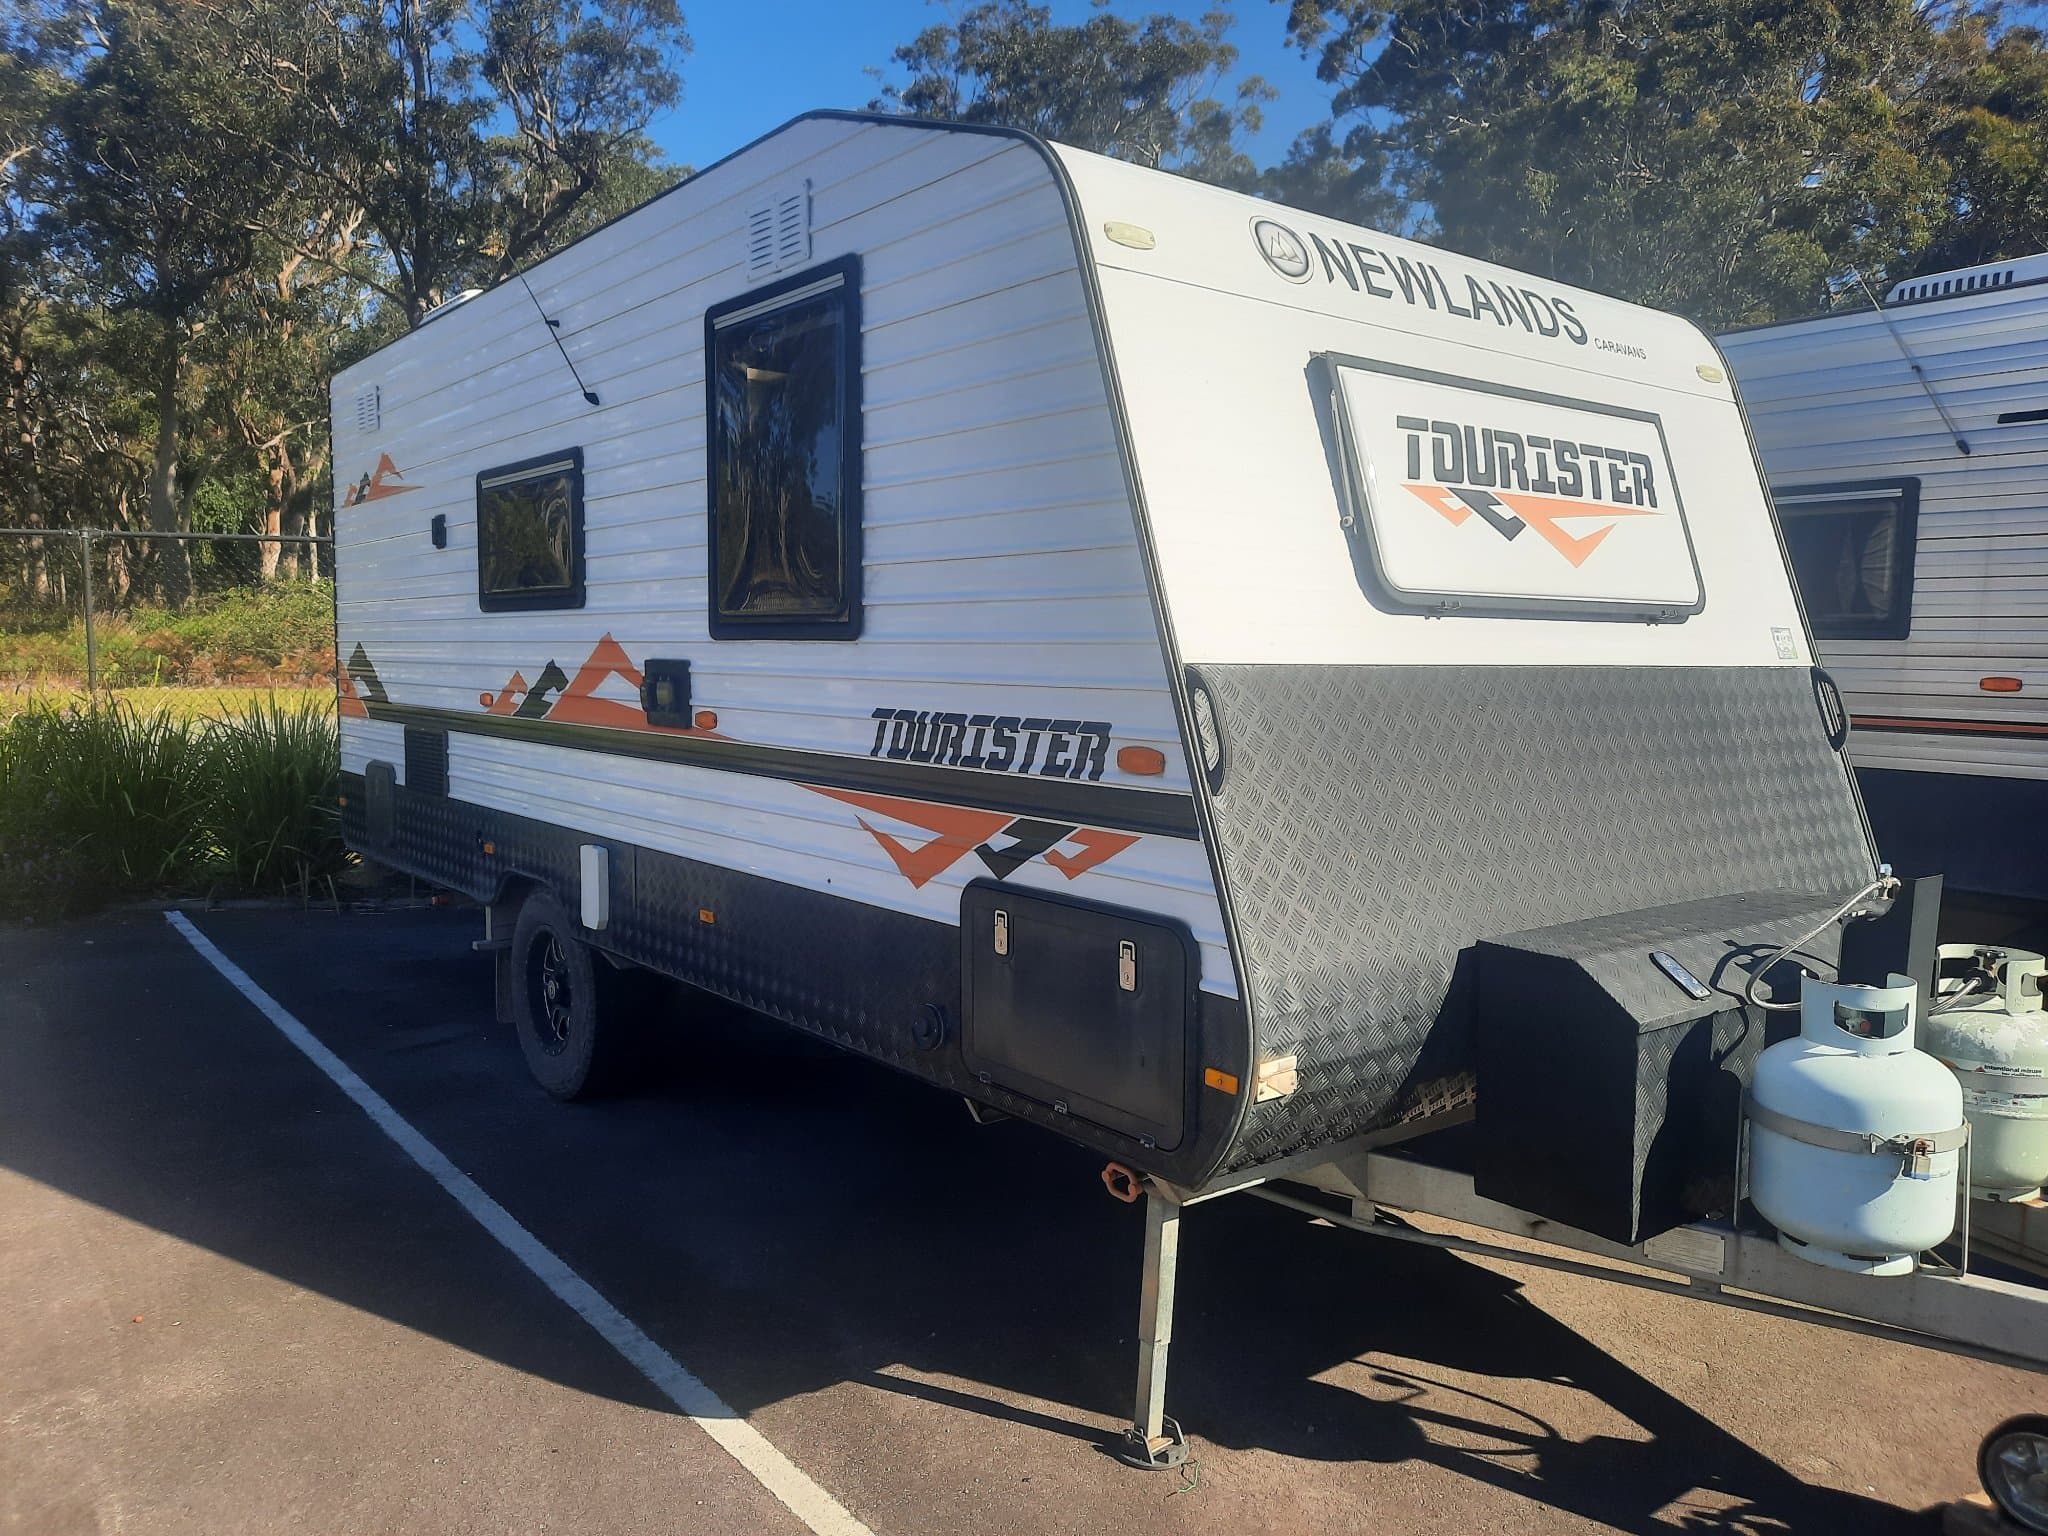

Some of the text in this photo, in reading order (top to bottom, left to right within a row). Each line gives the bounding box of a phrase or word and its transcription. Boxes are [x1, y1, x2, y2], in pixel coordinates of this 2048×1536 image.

[1308, 232, 1588, 345] NEWLANDS
[1594, 337, 1647, 360] CARAVANS
[1396, 415, 1658, 508] TOURISTER
[870, 707, 1112, 781] TOURISTER
